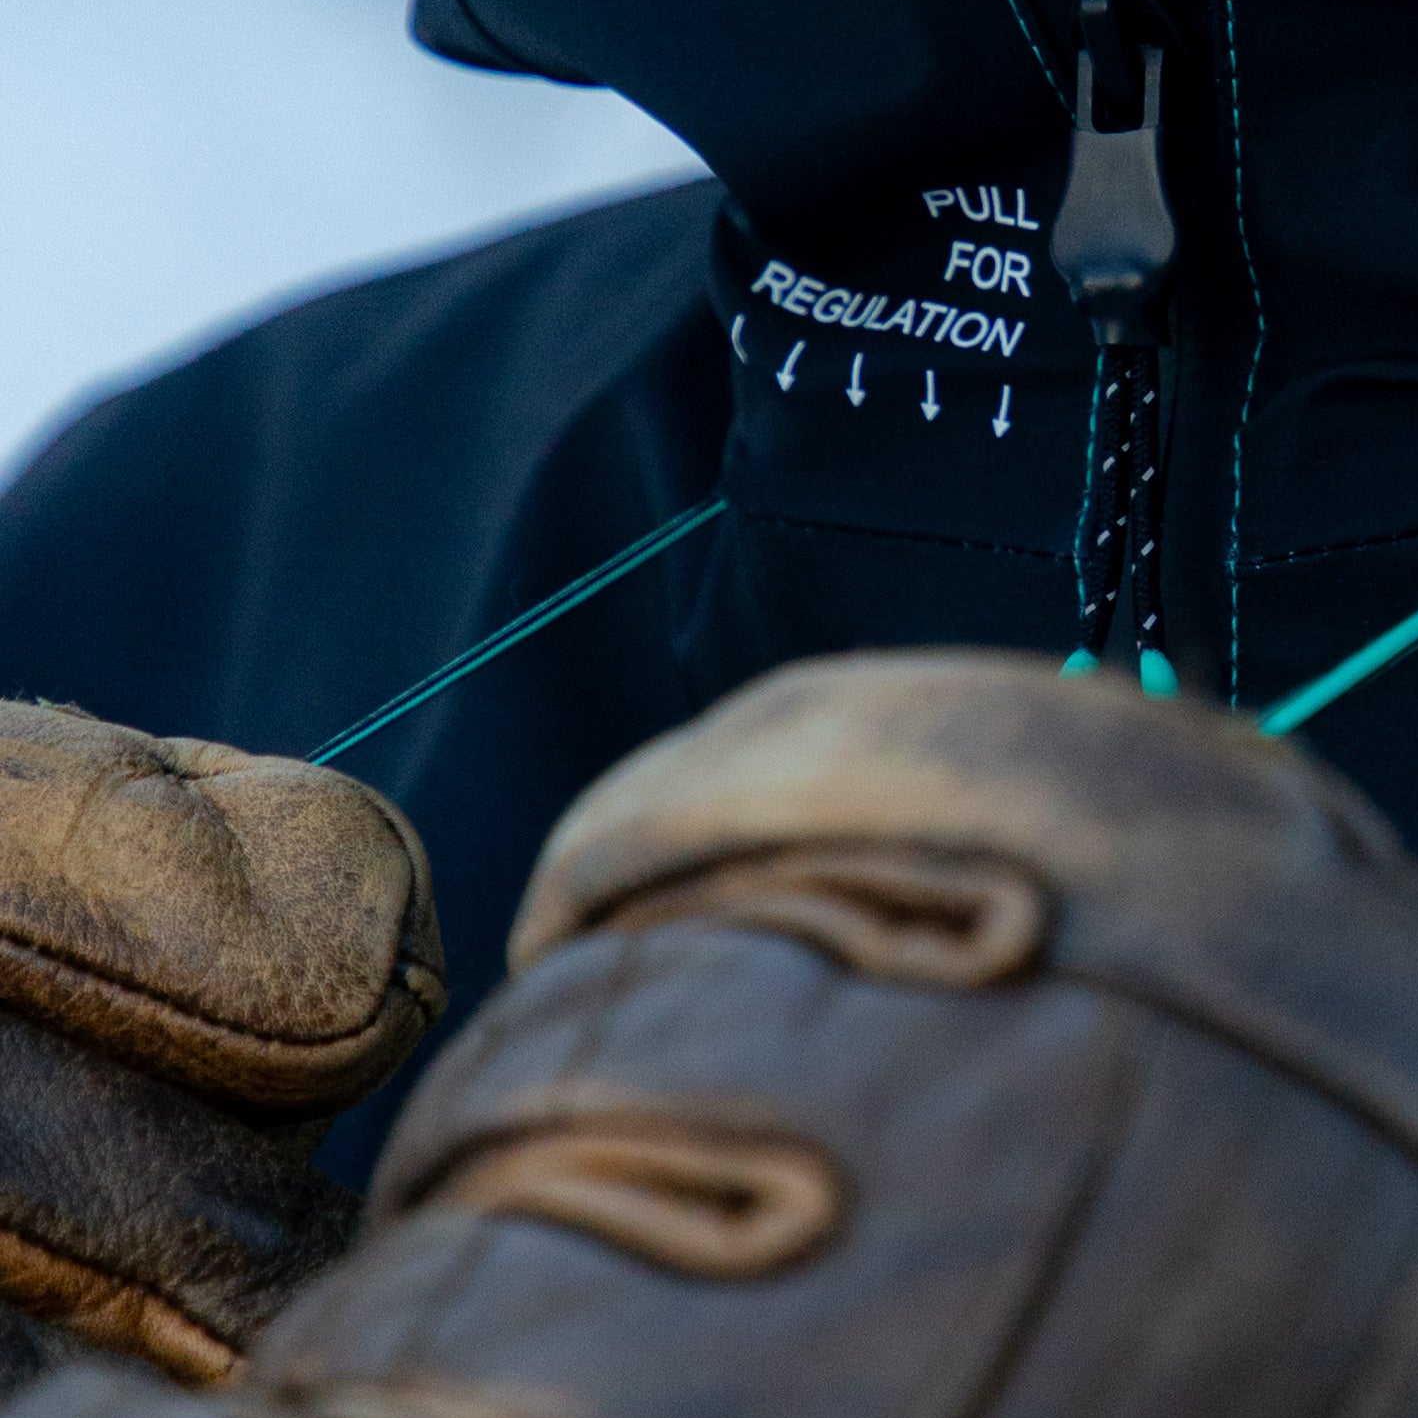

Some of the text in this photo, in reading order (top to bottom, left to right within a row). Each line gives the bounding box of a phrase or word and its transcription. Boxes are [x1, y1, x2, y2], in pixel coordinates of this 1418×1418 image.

[922, 186, 1040, 230] PULL
[944, 240, 1032, 297] FOR
[751, 260, 1026, 357] REGULATION
